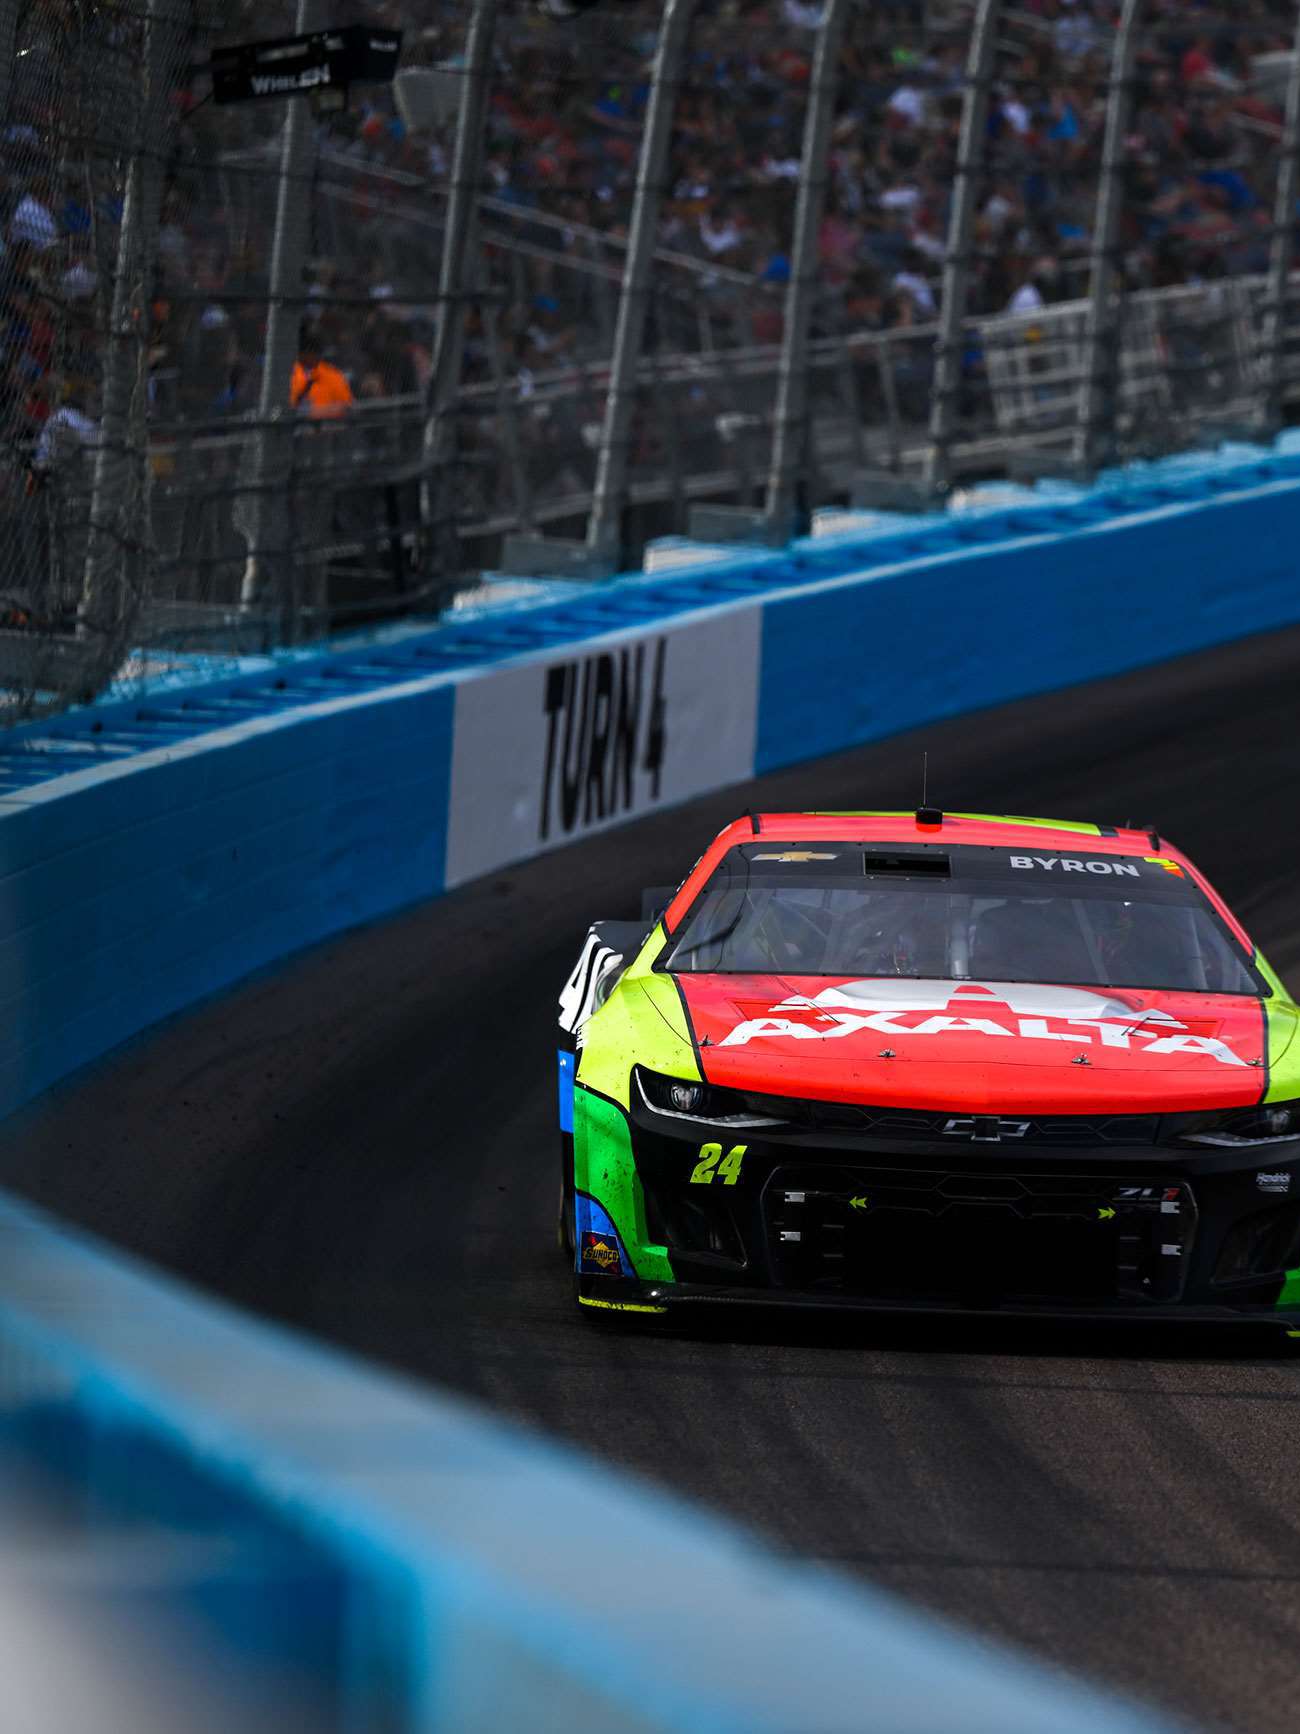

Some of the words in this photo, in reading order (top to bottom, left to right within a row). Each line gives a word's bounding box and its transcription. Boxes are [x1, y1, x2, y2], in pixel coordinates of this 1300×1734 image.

[538, 641, 645, 842] TURN
[643, 634, 667, 801] 4
[1009, 855, 1140, 877] BYRON
[718, 1010, 1250, 1067] AXALTA
[690, 1142, 748, 1185] 24
[583, 1247, 619, 1263] SUNOCO
